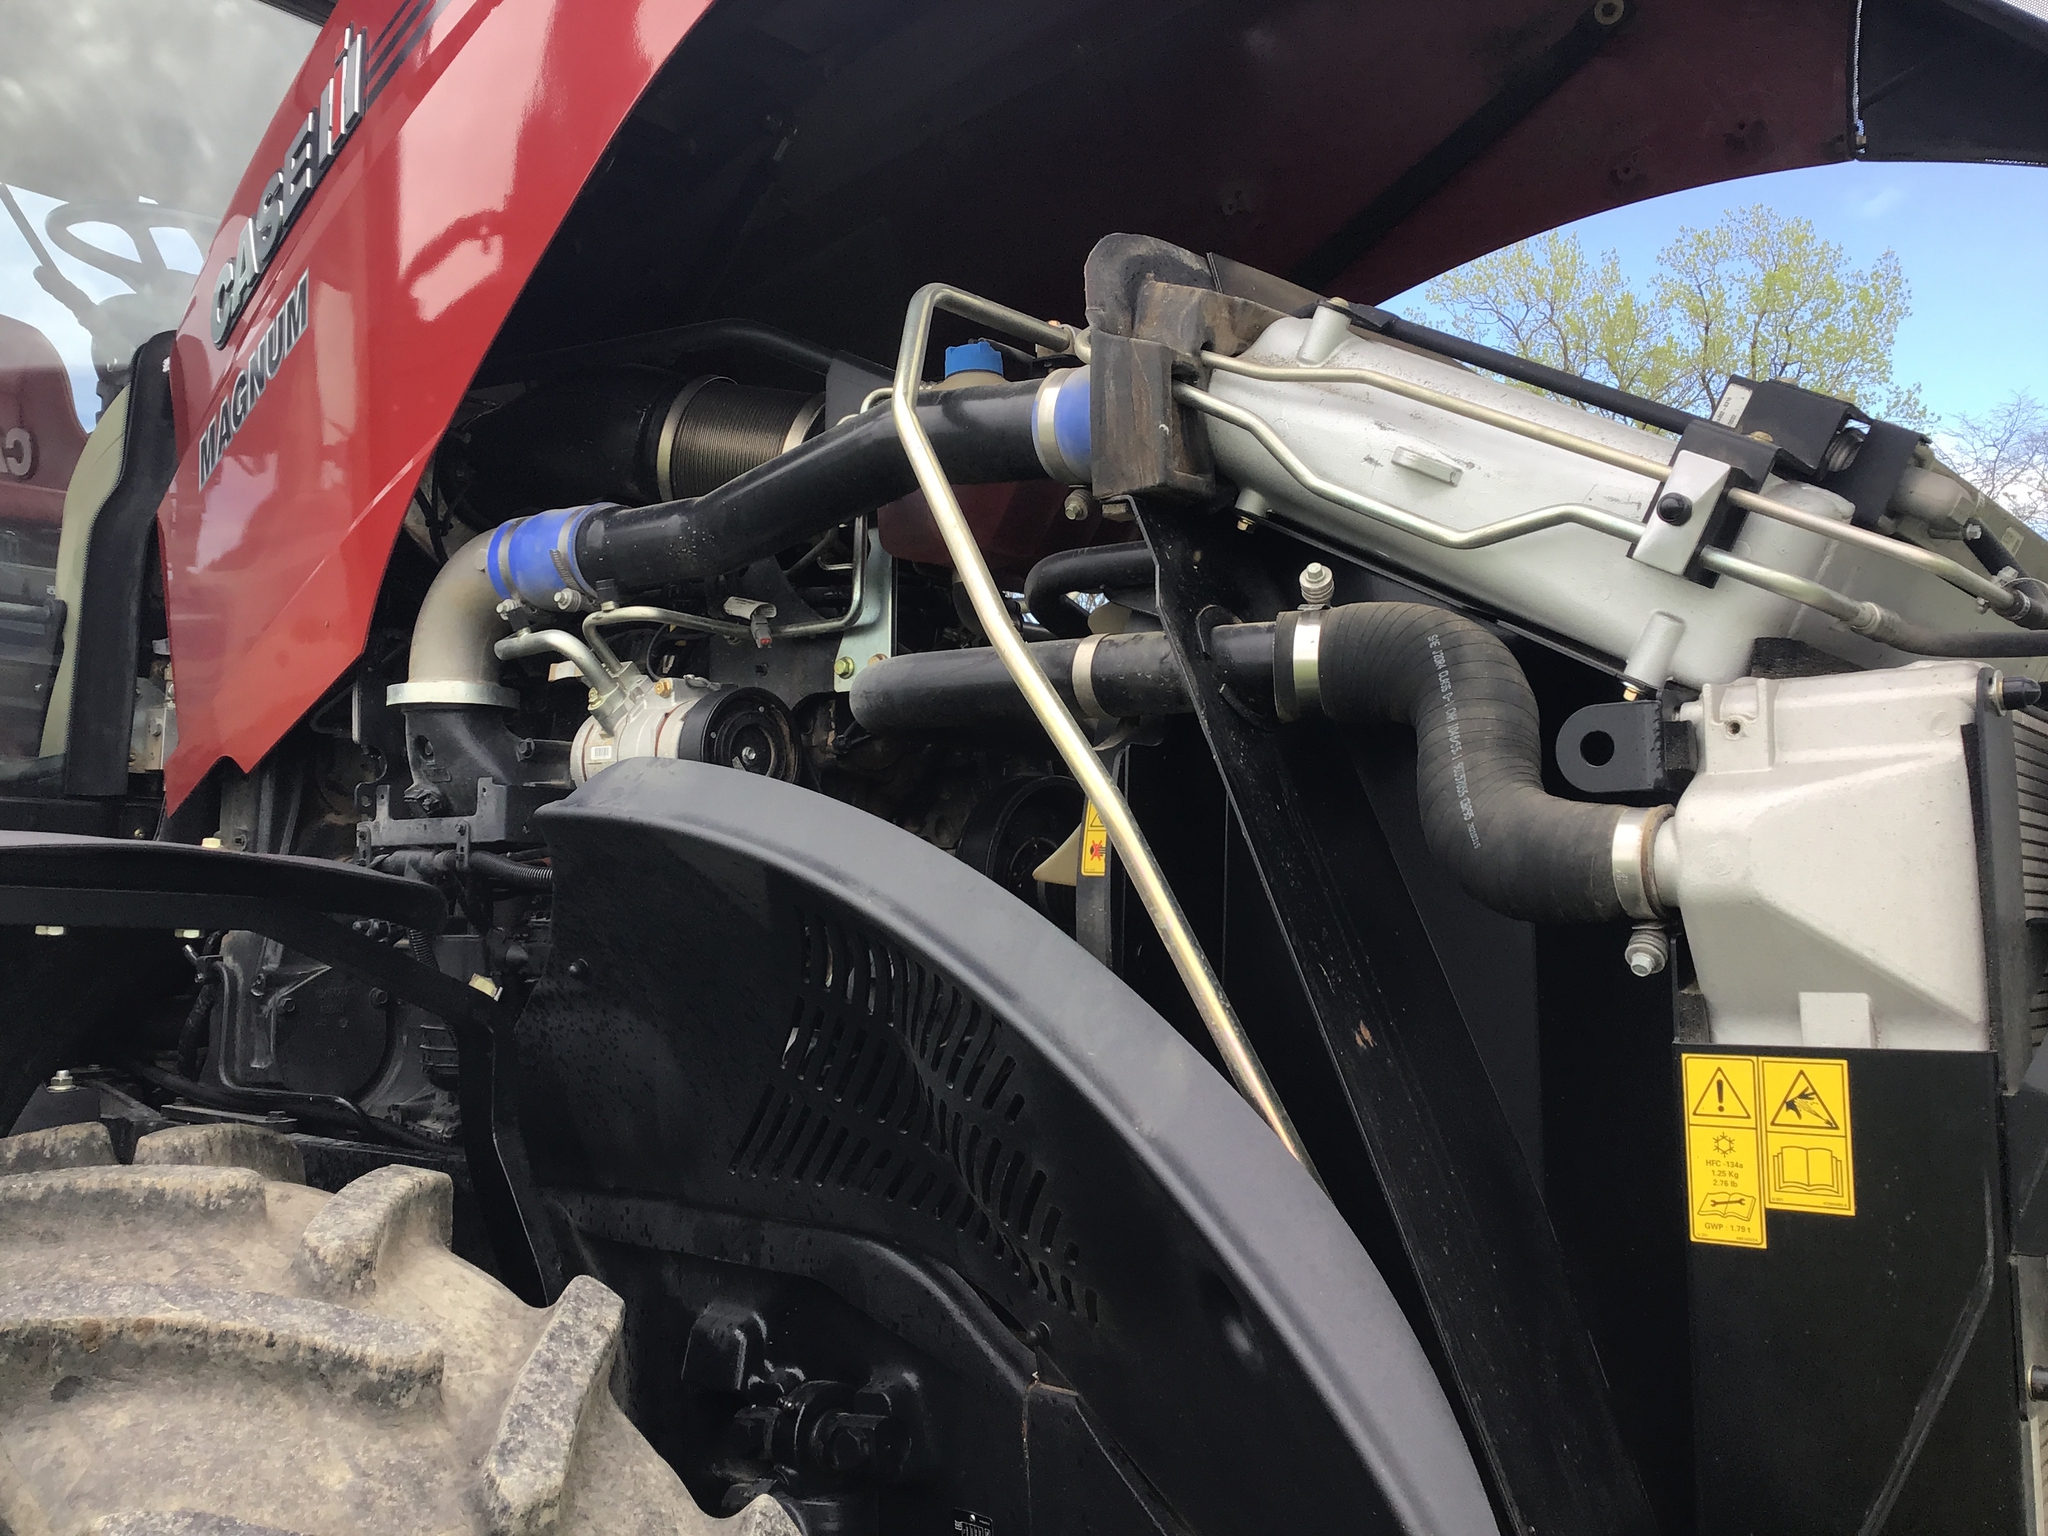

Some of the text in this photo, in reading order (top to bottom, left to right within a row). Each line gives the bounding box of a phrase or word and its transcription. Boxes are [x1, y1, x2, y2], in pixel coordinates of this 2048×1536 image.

[210, 106, 320, 350] CASE
[199, 266, 310, 493] MAGNUM
[1438, 670, 1452, 692] CLASS
[1705, 1159, 1744, 1169] HFC -134a
[1711, 1169, 1739, 1179] 1.25 Kg
[1712, 1179, 1738, 1188] 2.76 lb
[1704, 1222, 1724, 1230] GWP
[1730, 1224, 1746, 1233] 1.79
